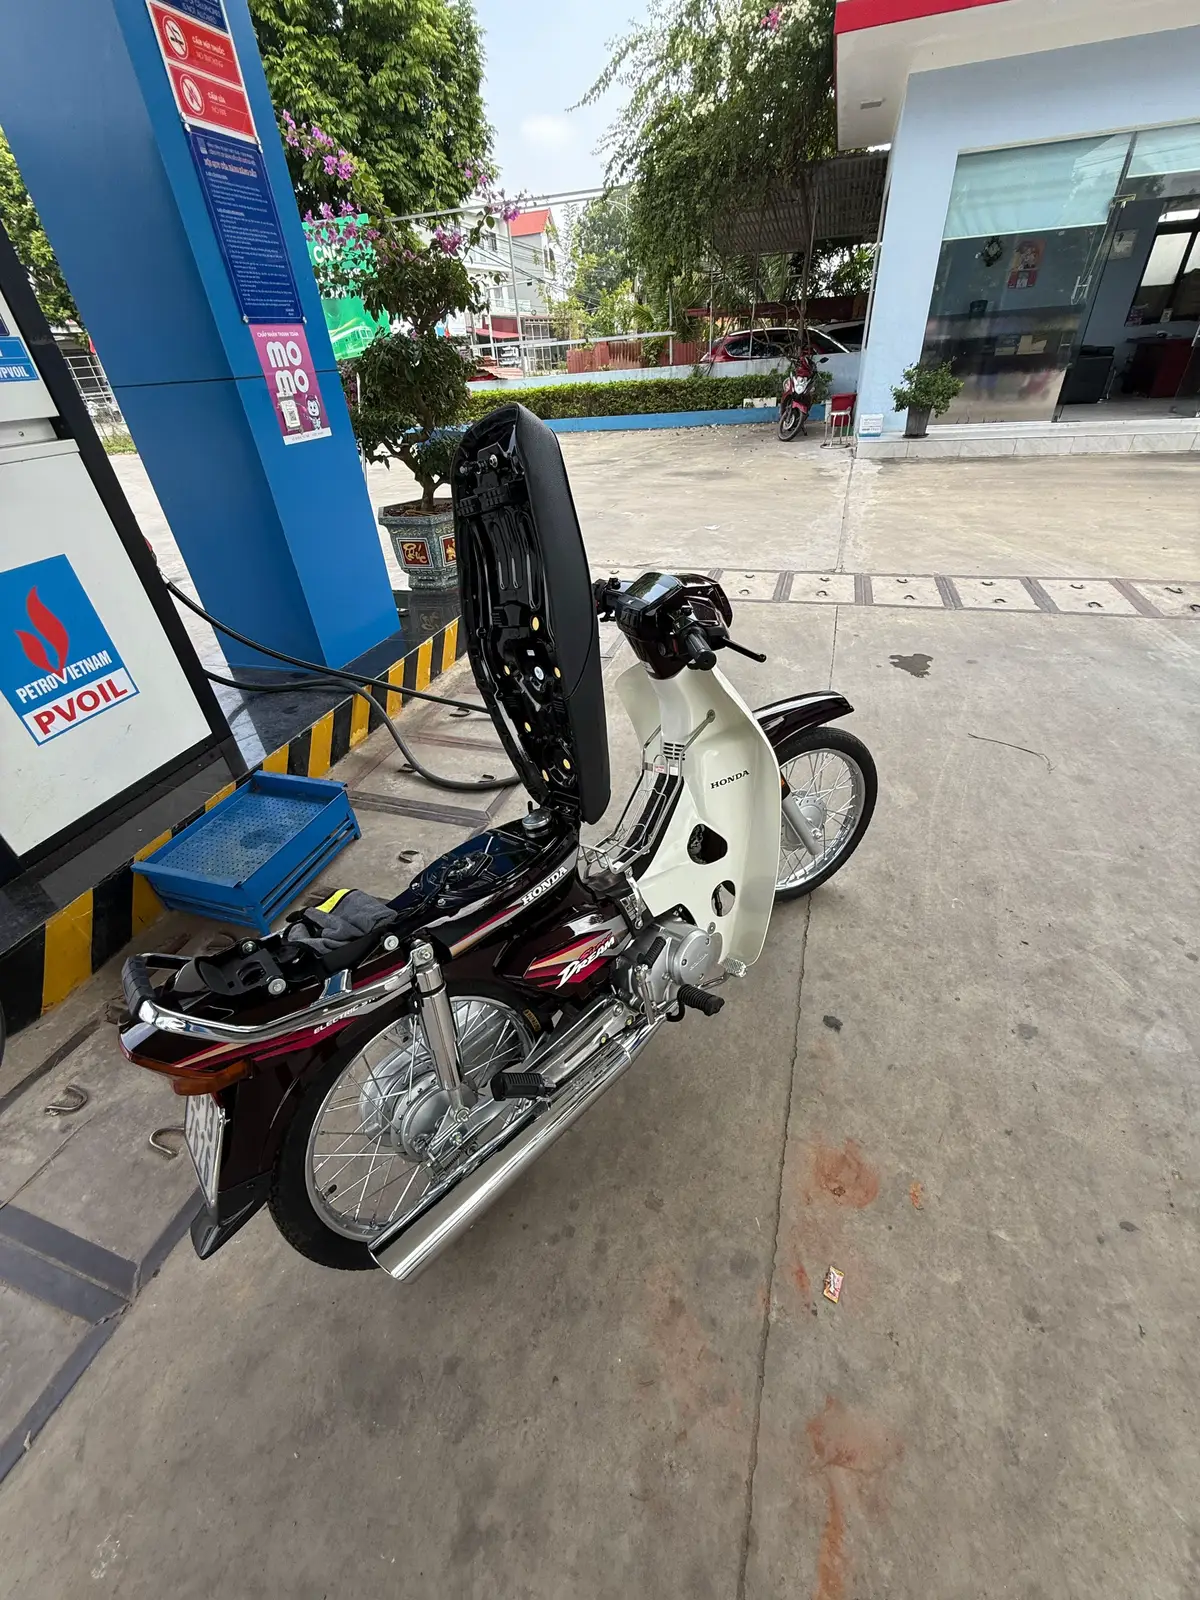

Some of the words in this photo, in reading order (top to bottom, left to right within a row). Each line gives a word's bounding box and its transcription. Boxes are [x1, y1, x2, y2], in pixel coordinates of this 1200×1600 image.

[33, 678, 128, 735] PVOIL
[710, 769, 750, 790] HONDA
[521, 866, 568, 906] HONDA
[313, 1004, 359, 1035] ELECTRIC
